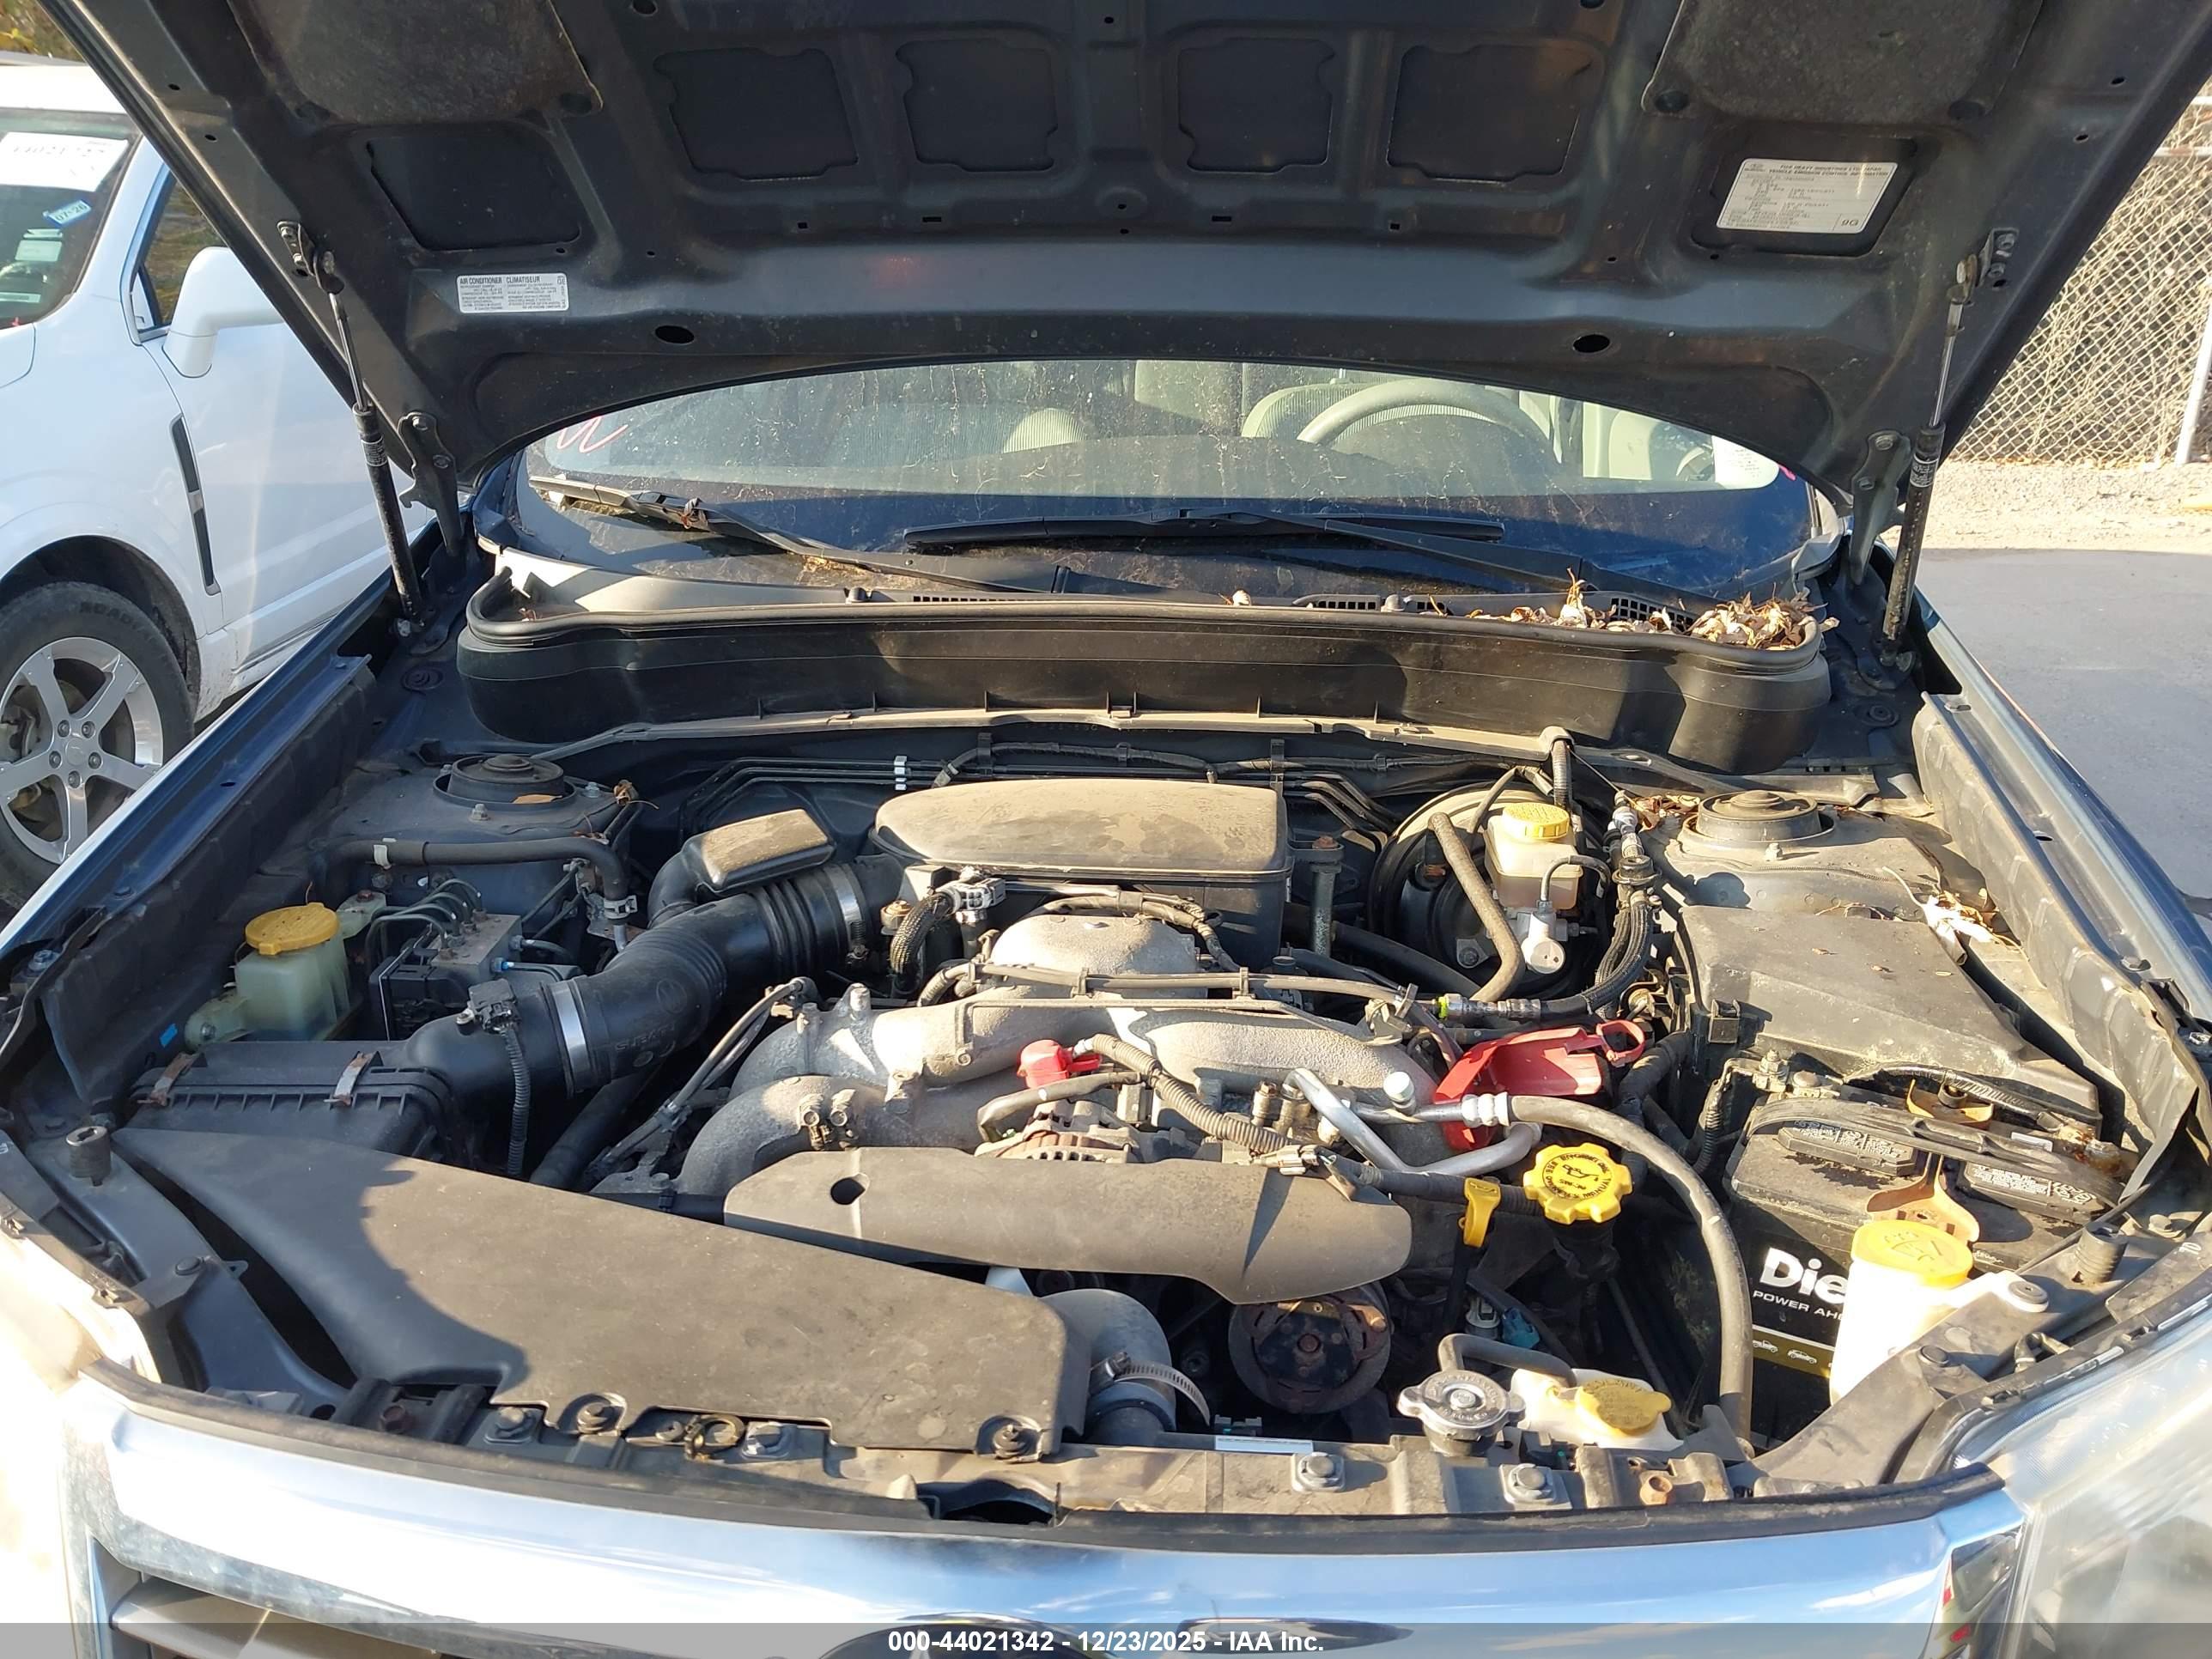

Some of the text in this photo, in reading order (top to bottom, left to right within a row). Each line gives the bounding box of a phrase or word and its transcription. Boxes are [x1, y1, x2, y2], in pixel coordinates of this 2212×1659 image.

[469, 276, 502, 285] CONDITIONER
[506, 276, 541, 284] CLIMATISEUR
[1753, 1291, 1810, 1312] POWER
